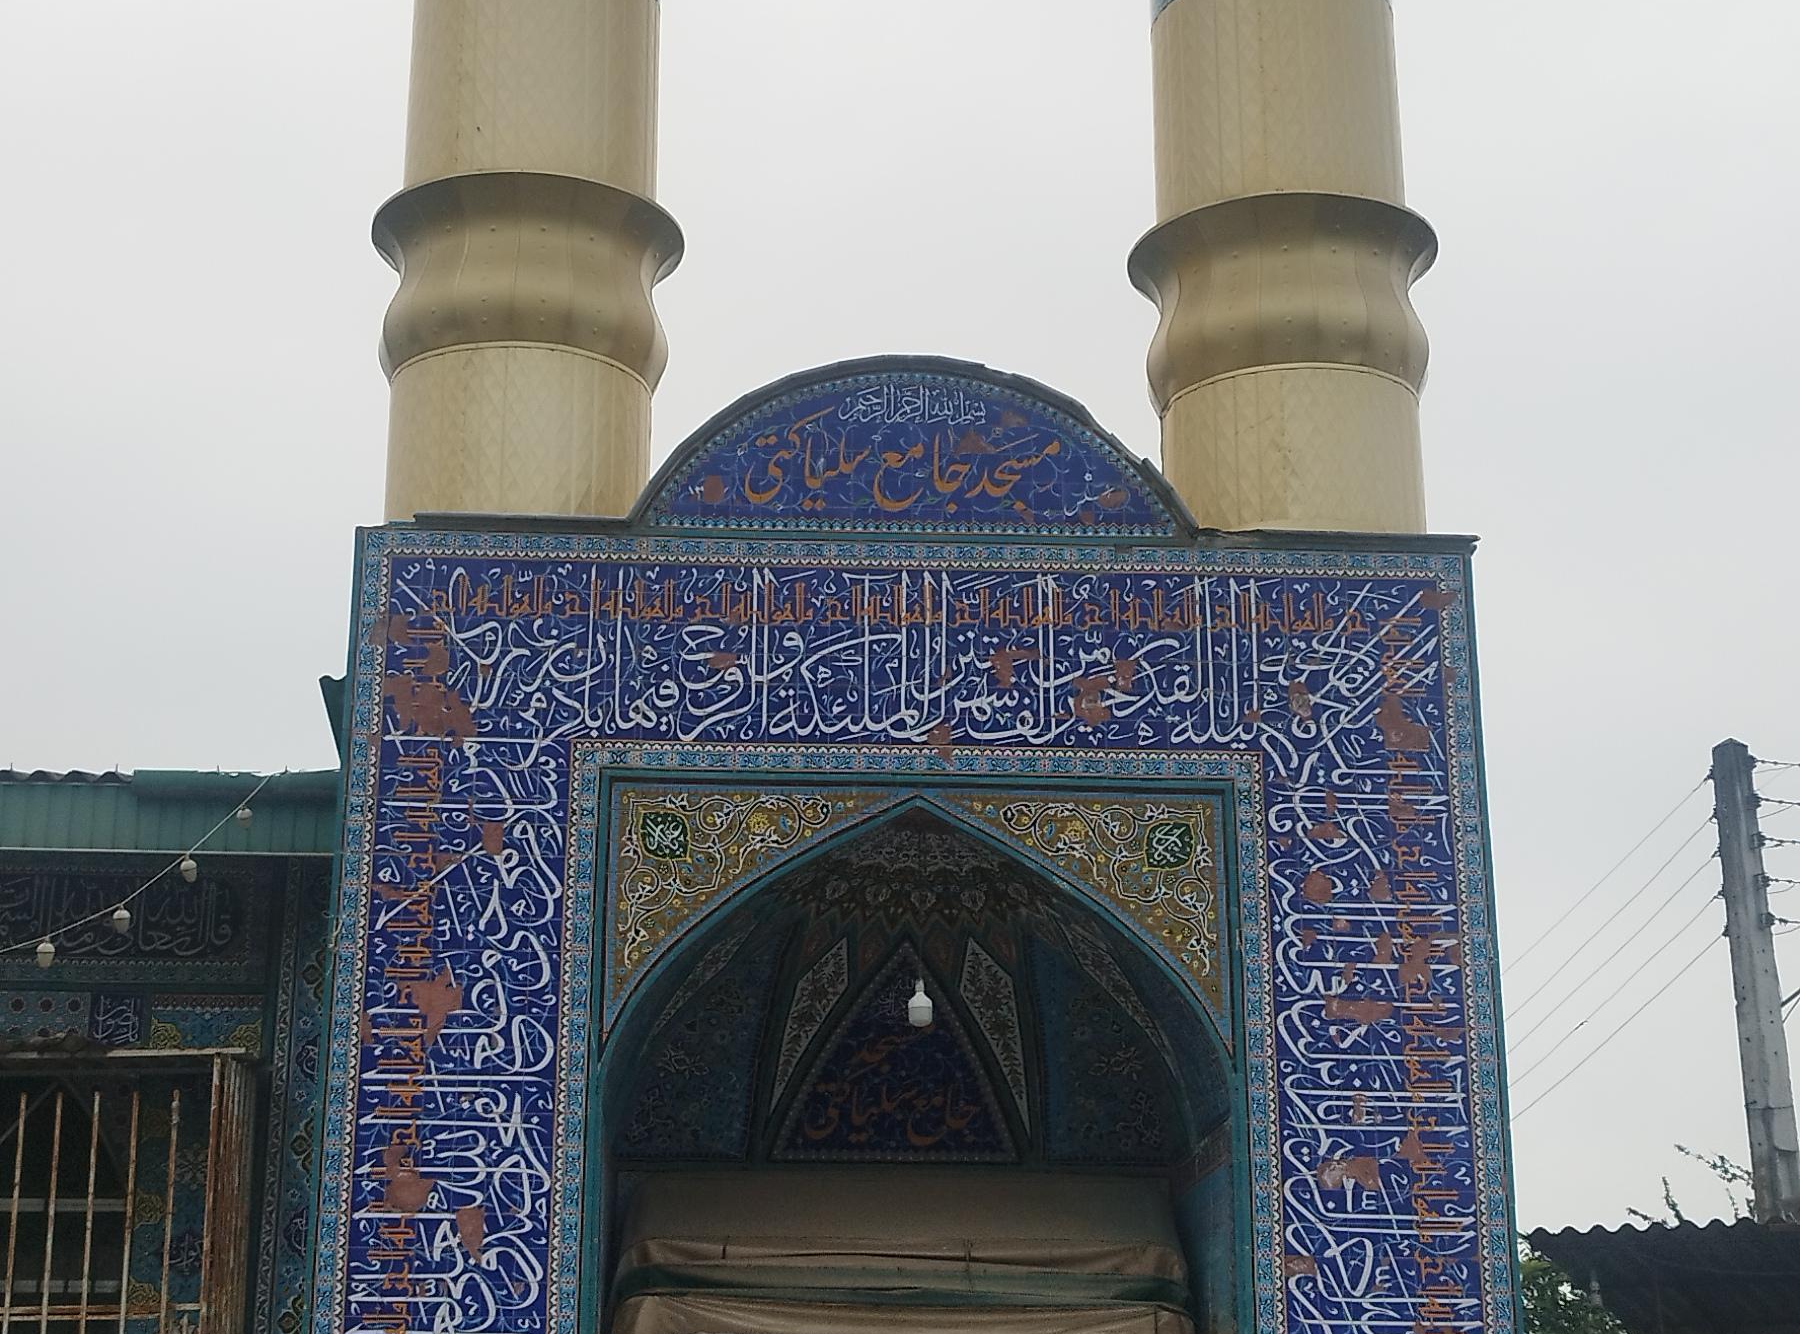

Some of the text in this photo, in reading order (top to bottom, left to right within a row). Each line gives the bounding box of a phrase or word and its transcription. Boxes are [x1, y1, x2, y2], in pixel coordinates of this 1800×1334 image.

[838, 385, 893, 423] الرحیم
[884, 385, 929, 424] الرحمن
[873, 432, 973, 514] جامع
[964, 434, 1062, 514] مسجد
